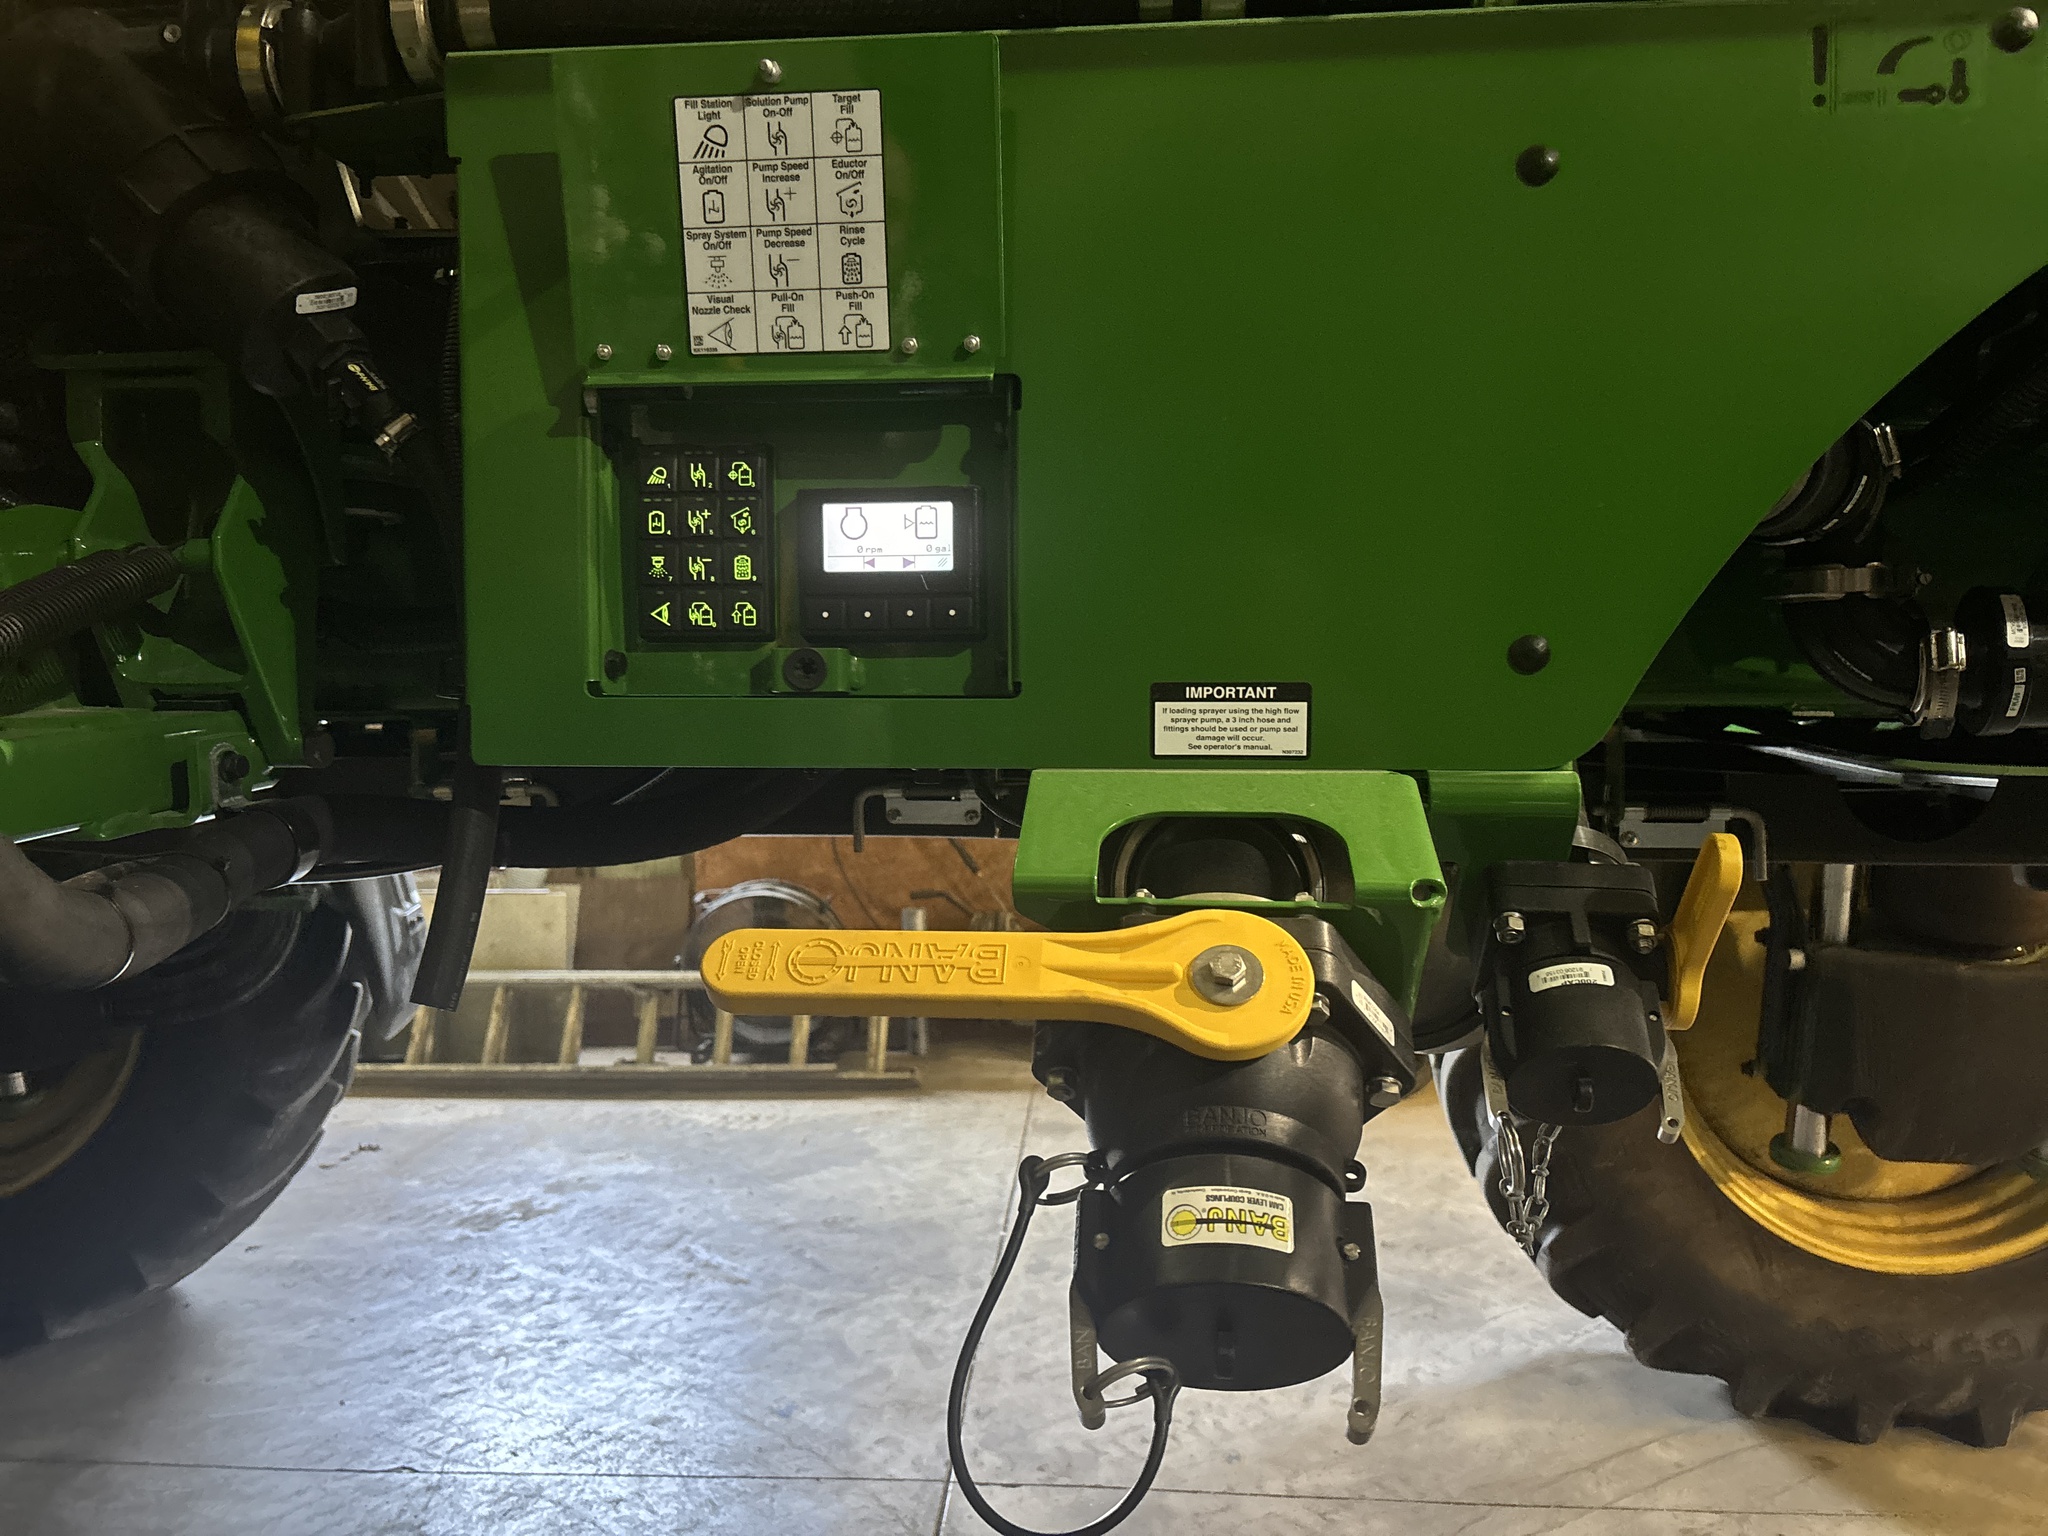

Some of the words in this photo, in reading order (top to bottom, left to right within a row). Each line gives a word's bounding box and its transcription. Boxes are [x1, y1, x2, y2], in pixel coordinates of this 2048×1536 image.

[684, 100, 698, 109] Fill
[700, 99, 732, 109] Station
[745, 97, 782, 107] Solution
[784, 96, 809, 106] Pump
[832, 94, 861, 105] Target
[763, 108, 793, 117] On-Off
[840, 105, 854, 114] Fill
[697, 111, 721, 122] Light
[753, 163, 778, 174] Pump
[780, 161, 809, 172] Speed
[831, 159, 867, 169] Eductor
[692, 164, 733, 176] Agitation
[835, 170, 865, 180] On/Off
[699, 175, 728, 185] On/Off
[762, 173, 800, 183] Increase
[756, 228, 782, 239] Pump
[784, 227, 812, 238] Speed
[839, 225, 865, 234] Rinse
[686, 231, 712, 242] Spray
[714, 230, 747, 241] System
[840, 236, 865, 246] Cycle
[703, 241, 732, 251] On/Off
[764, 239, 806, 249] Decrease
[706, 295, 735, 304] Visual
[771, 292, 804, 302] Pull-On
[835, 290, 875, 300] Push-On
[692, 306, 721, 315] Nozzle
[723, 305, 751, 314] Check
[781, 303, 795, 313] Fill
[849, 301, 863, 311] Fill
[857, 545, 864, 553] 0
[865, 546, 883, 554] rpm
[926, 544, 932, 552] 0
[935, 544, 951, 553] gal
[1185, 686, 1277, 699] IMPORTANT
[1169, 707, 1197, 716] loading
[1198, 708, 1226, 716] sprayer
[1228, 707, 1250, 716] using
[1265, 707, 1282, 716] high
[1170, 717, 1198, 725] sprayer
[1200, 717, 1224, 725] pump,
[1163, 725, 1189, 733] fittings
[1259, 726, 1281, 734] pump
[1203, 743, 1241, 751] operator's
[733, 946, 751, 975] OPEN
[746, 940, 766, 981] CLOSED
[1274, 940, 1303, 972] MADE
[786, 937, 1009, 986] BANJO
[1290, 976, 1305, 990] IN
[1279, 993, 1302, 1014] USA
[1182, 1107, 1267, 1127] BANJO
[1205, 1194, 1246, 1203] COUPLINGS
[1247, 1197, 1268, 1207] LEVER
[1269, 1201, 1284, 1210] CAM
[1165, 1204, 1289, 1242] BANJO
